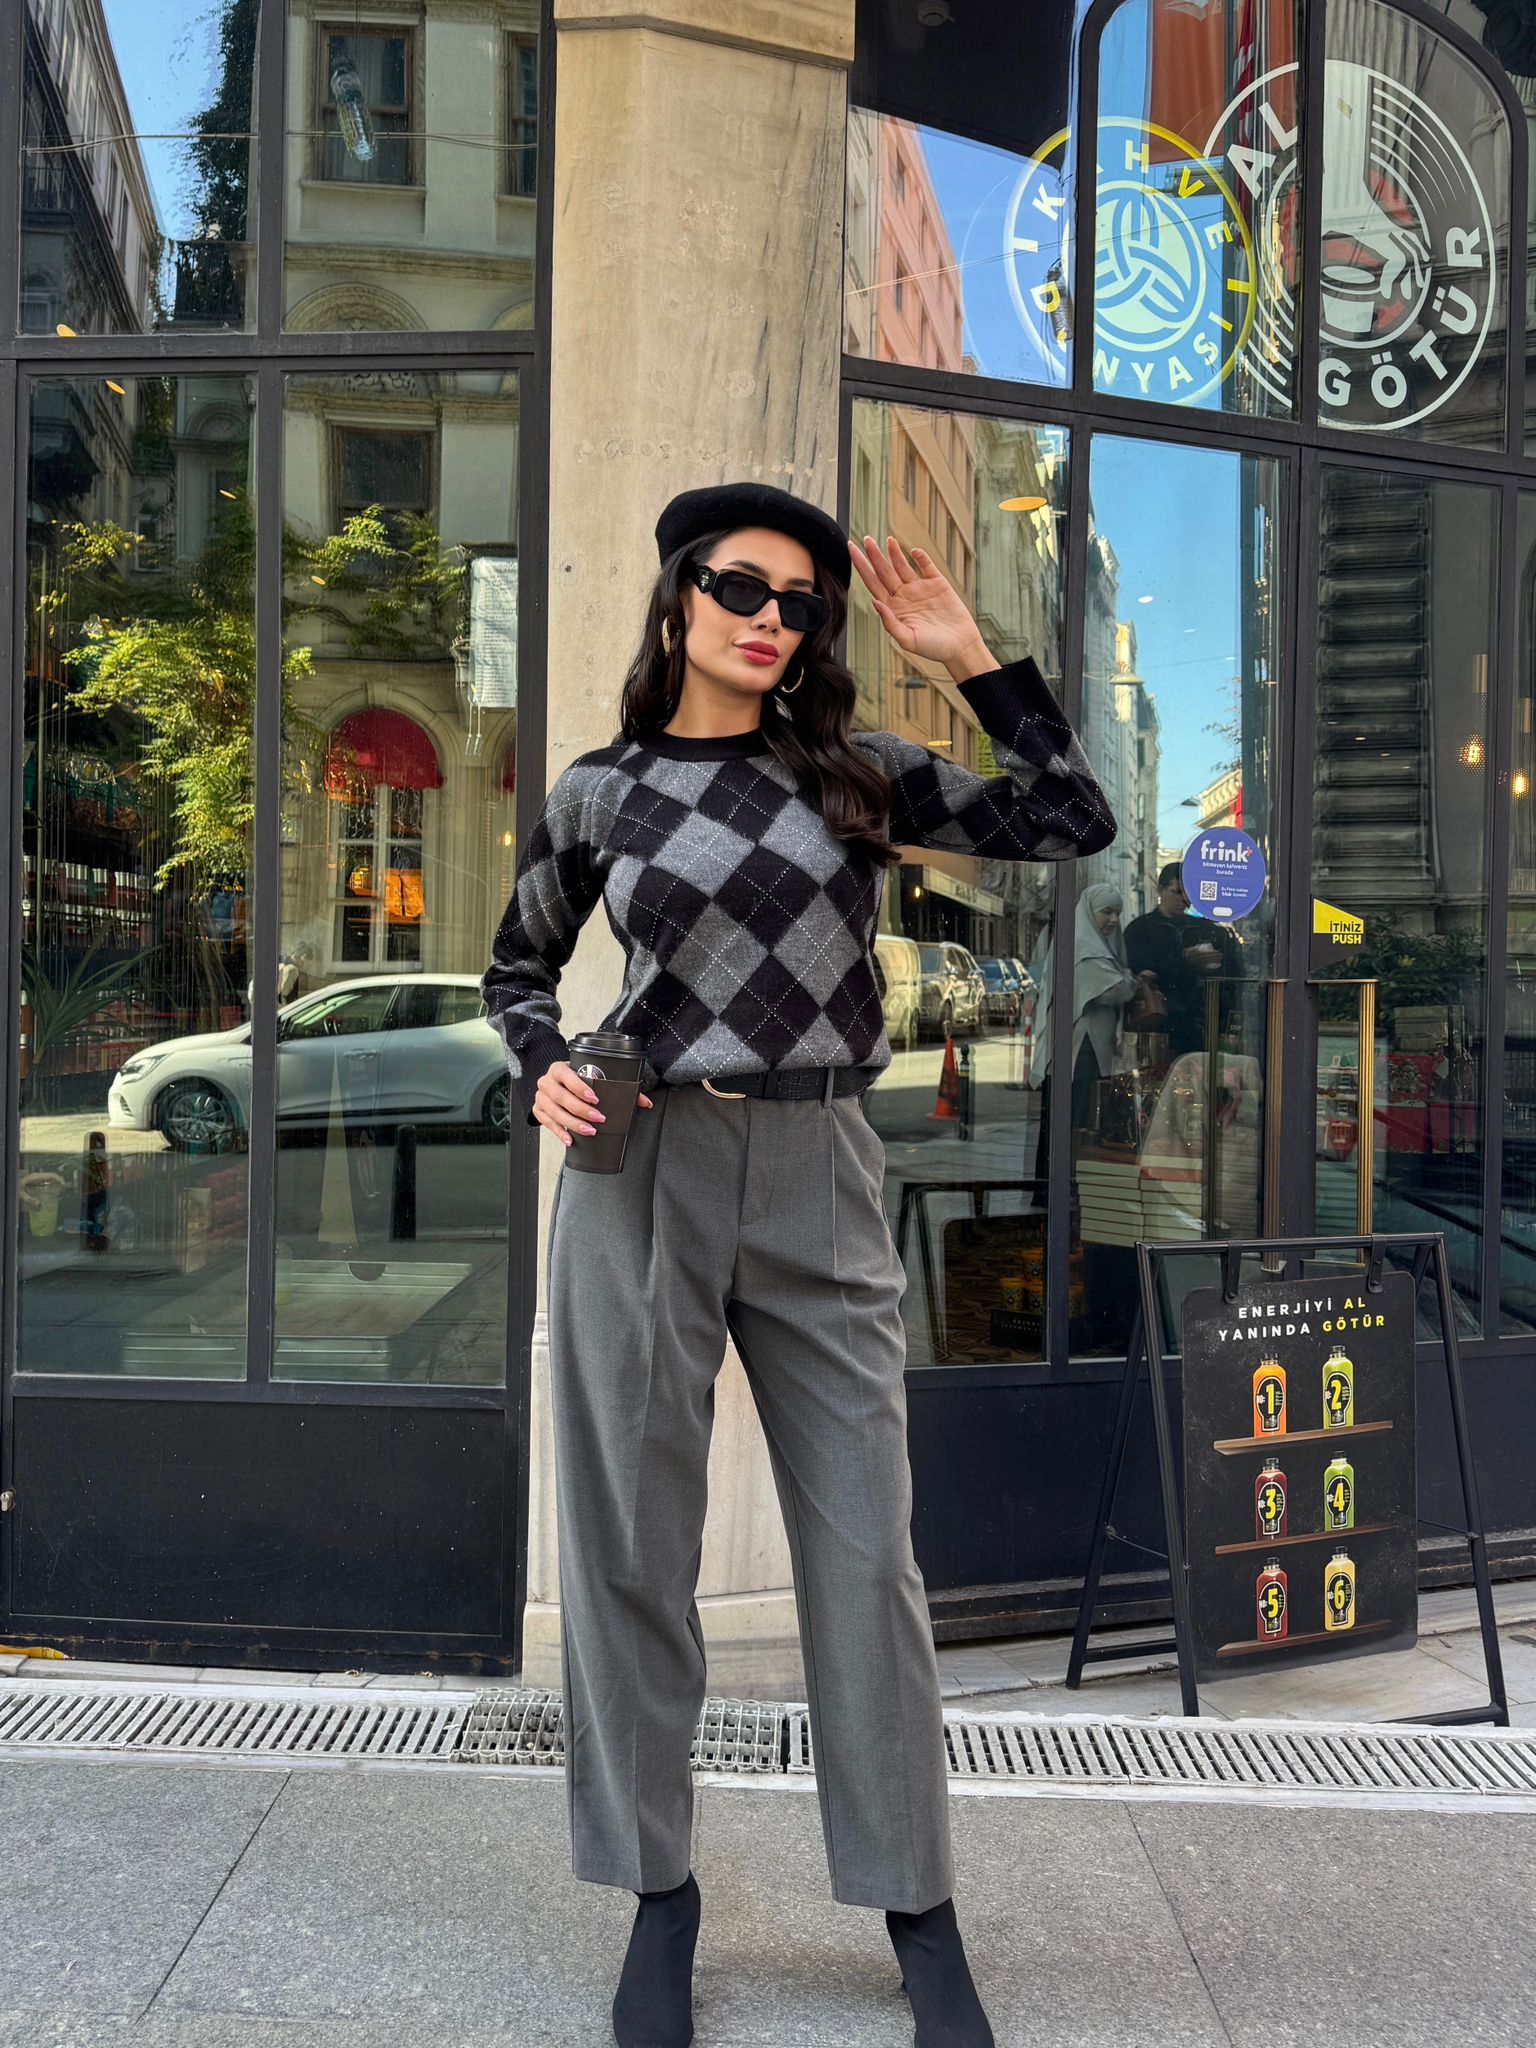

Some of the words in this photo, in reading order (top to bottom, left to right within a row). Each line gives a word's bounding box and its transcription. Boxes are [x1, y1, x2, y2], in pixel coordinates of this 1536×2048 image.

[1226, 101, 1298, 200] AL
[1032, 140, 1234, 251] KHVE
[1318, 226, 1484, 409] GÖTÜR
[1030, 281, 1234, 393] DNYASI
[1201, 839, 1249, 862] frink
[1329, 920, 1361, 933] İTİNİZ
[1332, 934, 1362, 945] PUSH
[1238, 1297, 1332, 1319] ENERJİYİ
[1343, 1297, 1366, 1310] AL
[1218, 1322, 1310, 1342] YANINDA
[1322, 1314, 1385, 1333] GÖTÜR
[1265, 1383, 1275, 1415] 1
[1330, 1379, 1342, 1410] 2
[1265, 1488, 1277, 1519] 3
[1333, 1482, 1345, 1512] 4
[1268, 1588, 1279, 1618] 5
[1334, 1579, 1345, 1610] 6
